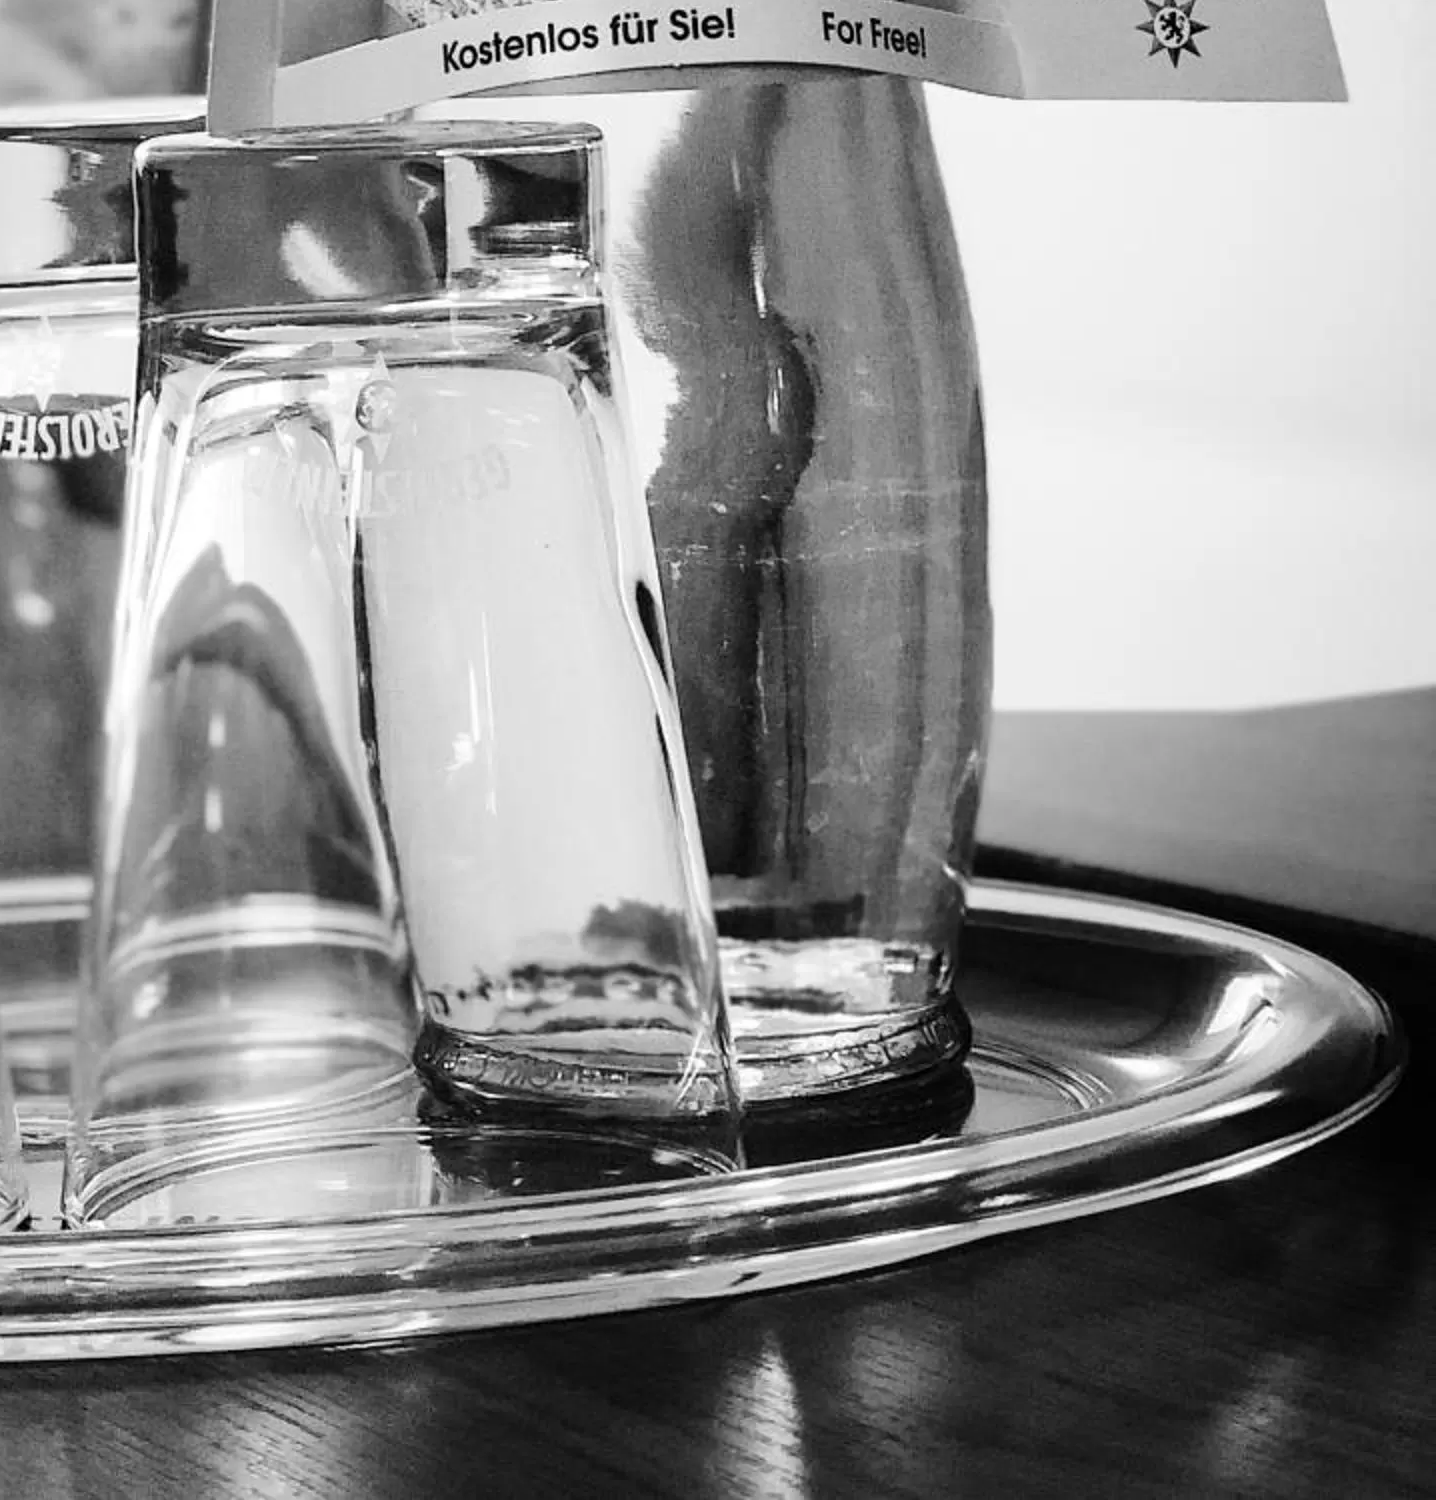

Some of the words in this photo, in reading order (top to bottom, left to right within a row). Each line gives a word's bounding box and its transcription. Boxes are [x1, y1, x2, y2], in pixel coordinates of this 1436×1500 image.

[441, 21, 599, 74] Kostenlos
[610, 12, 659, 46] für
[669, 7, 735, 42] Sie!
[821, 11, 865, 47] For
[870, 17, 928, 59] Free!
